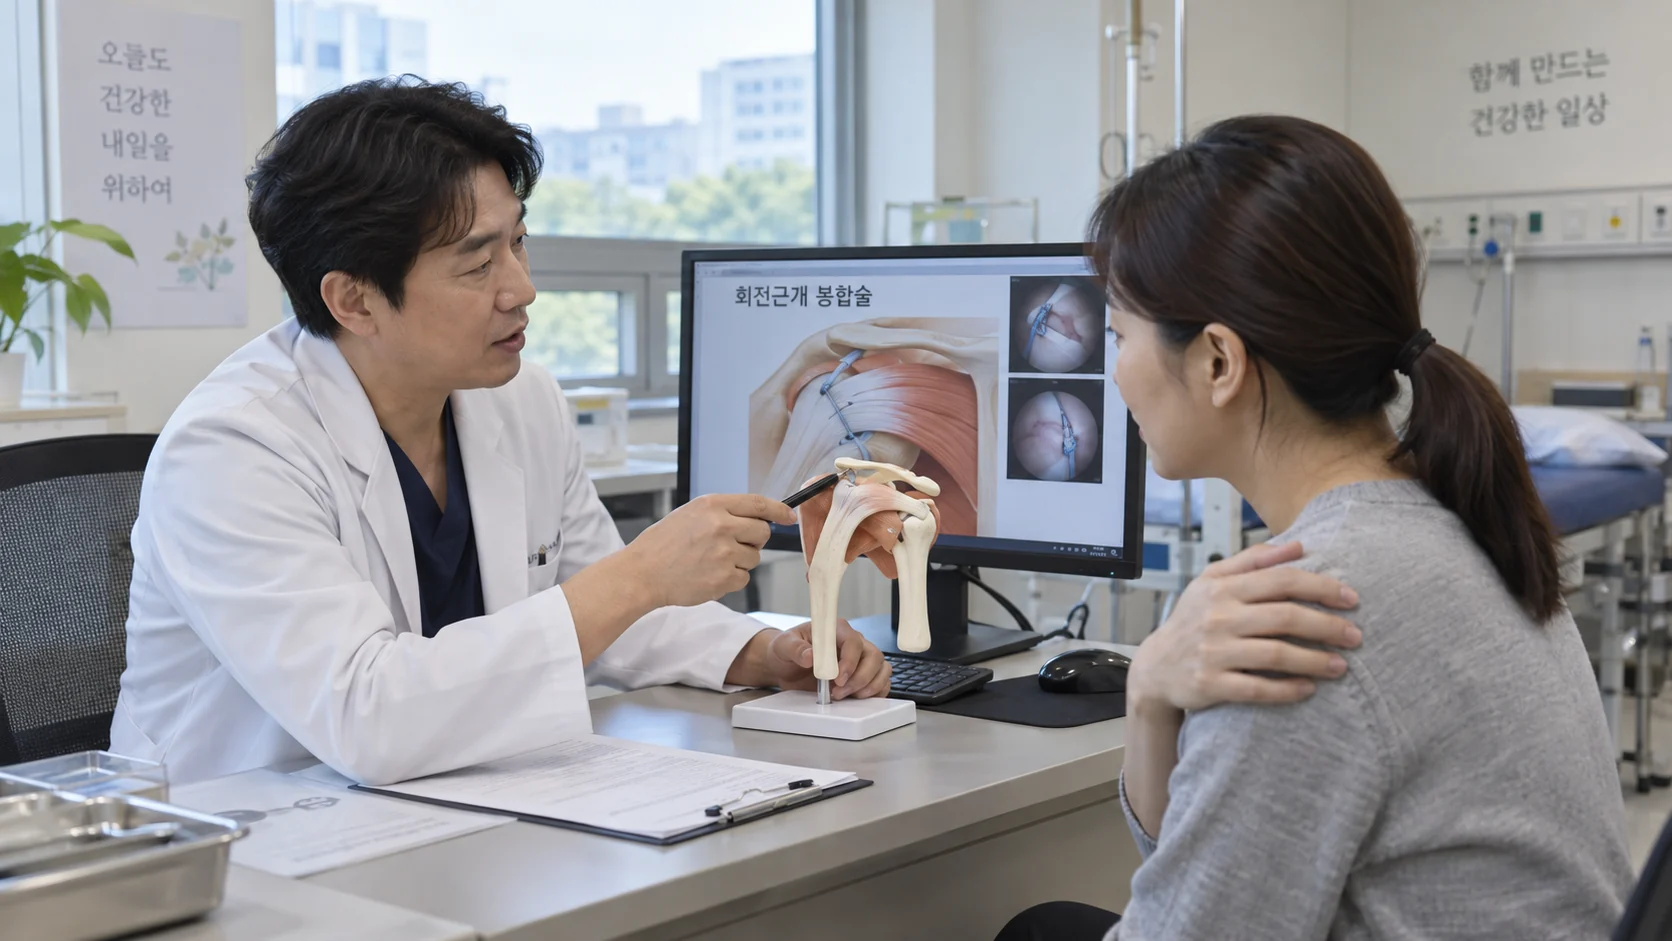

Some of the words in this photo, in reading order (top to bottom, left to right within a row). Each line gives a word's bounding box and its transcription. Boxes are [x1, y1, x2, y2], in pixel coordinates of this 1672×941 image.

[1530, 48, 1610, 85] 만드는
[100, 84, 171, 117] 건강한
[1470, 98, 1548, 137] 건강한
[1556, 92, 1609, 128] 일상
[101, 129, 173, 161] 내일을
[101, 173, 172, 204] 위하여
[734, 284, 808, 308] 회전근개
[815, 284, 873, 308] 봉합술
